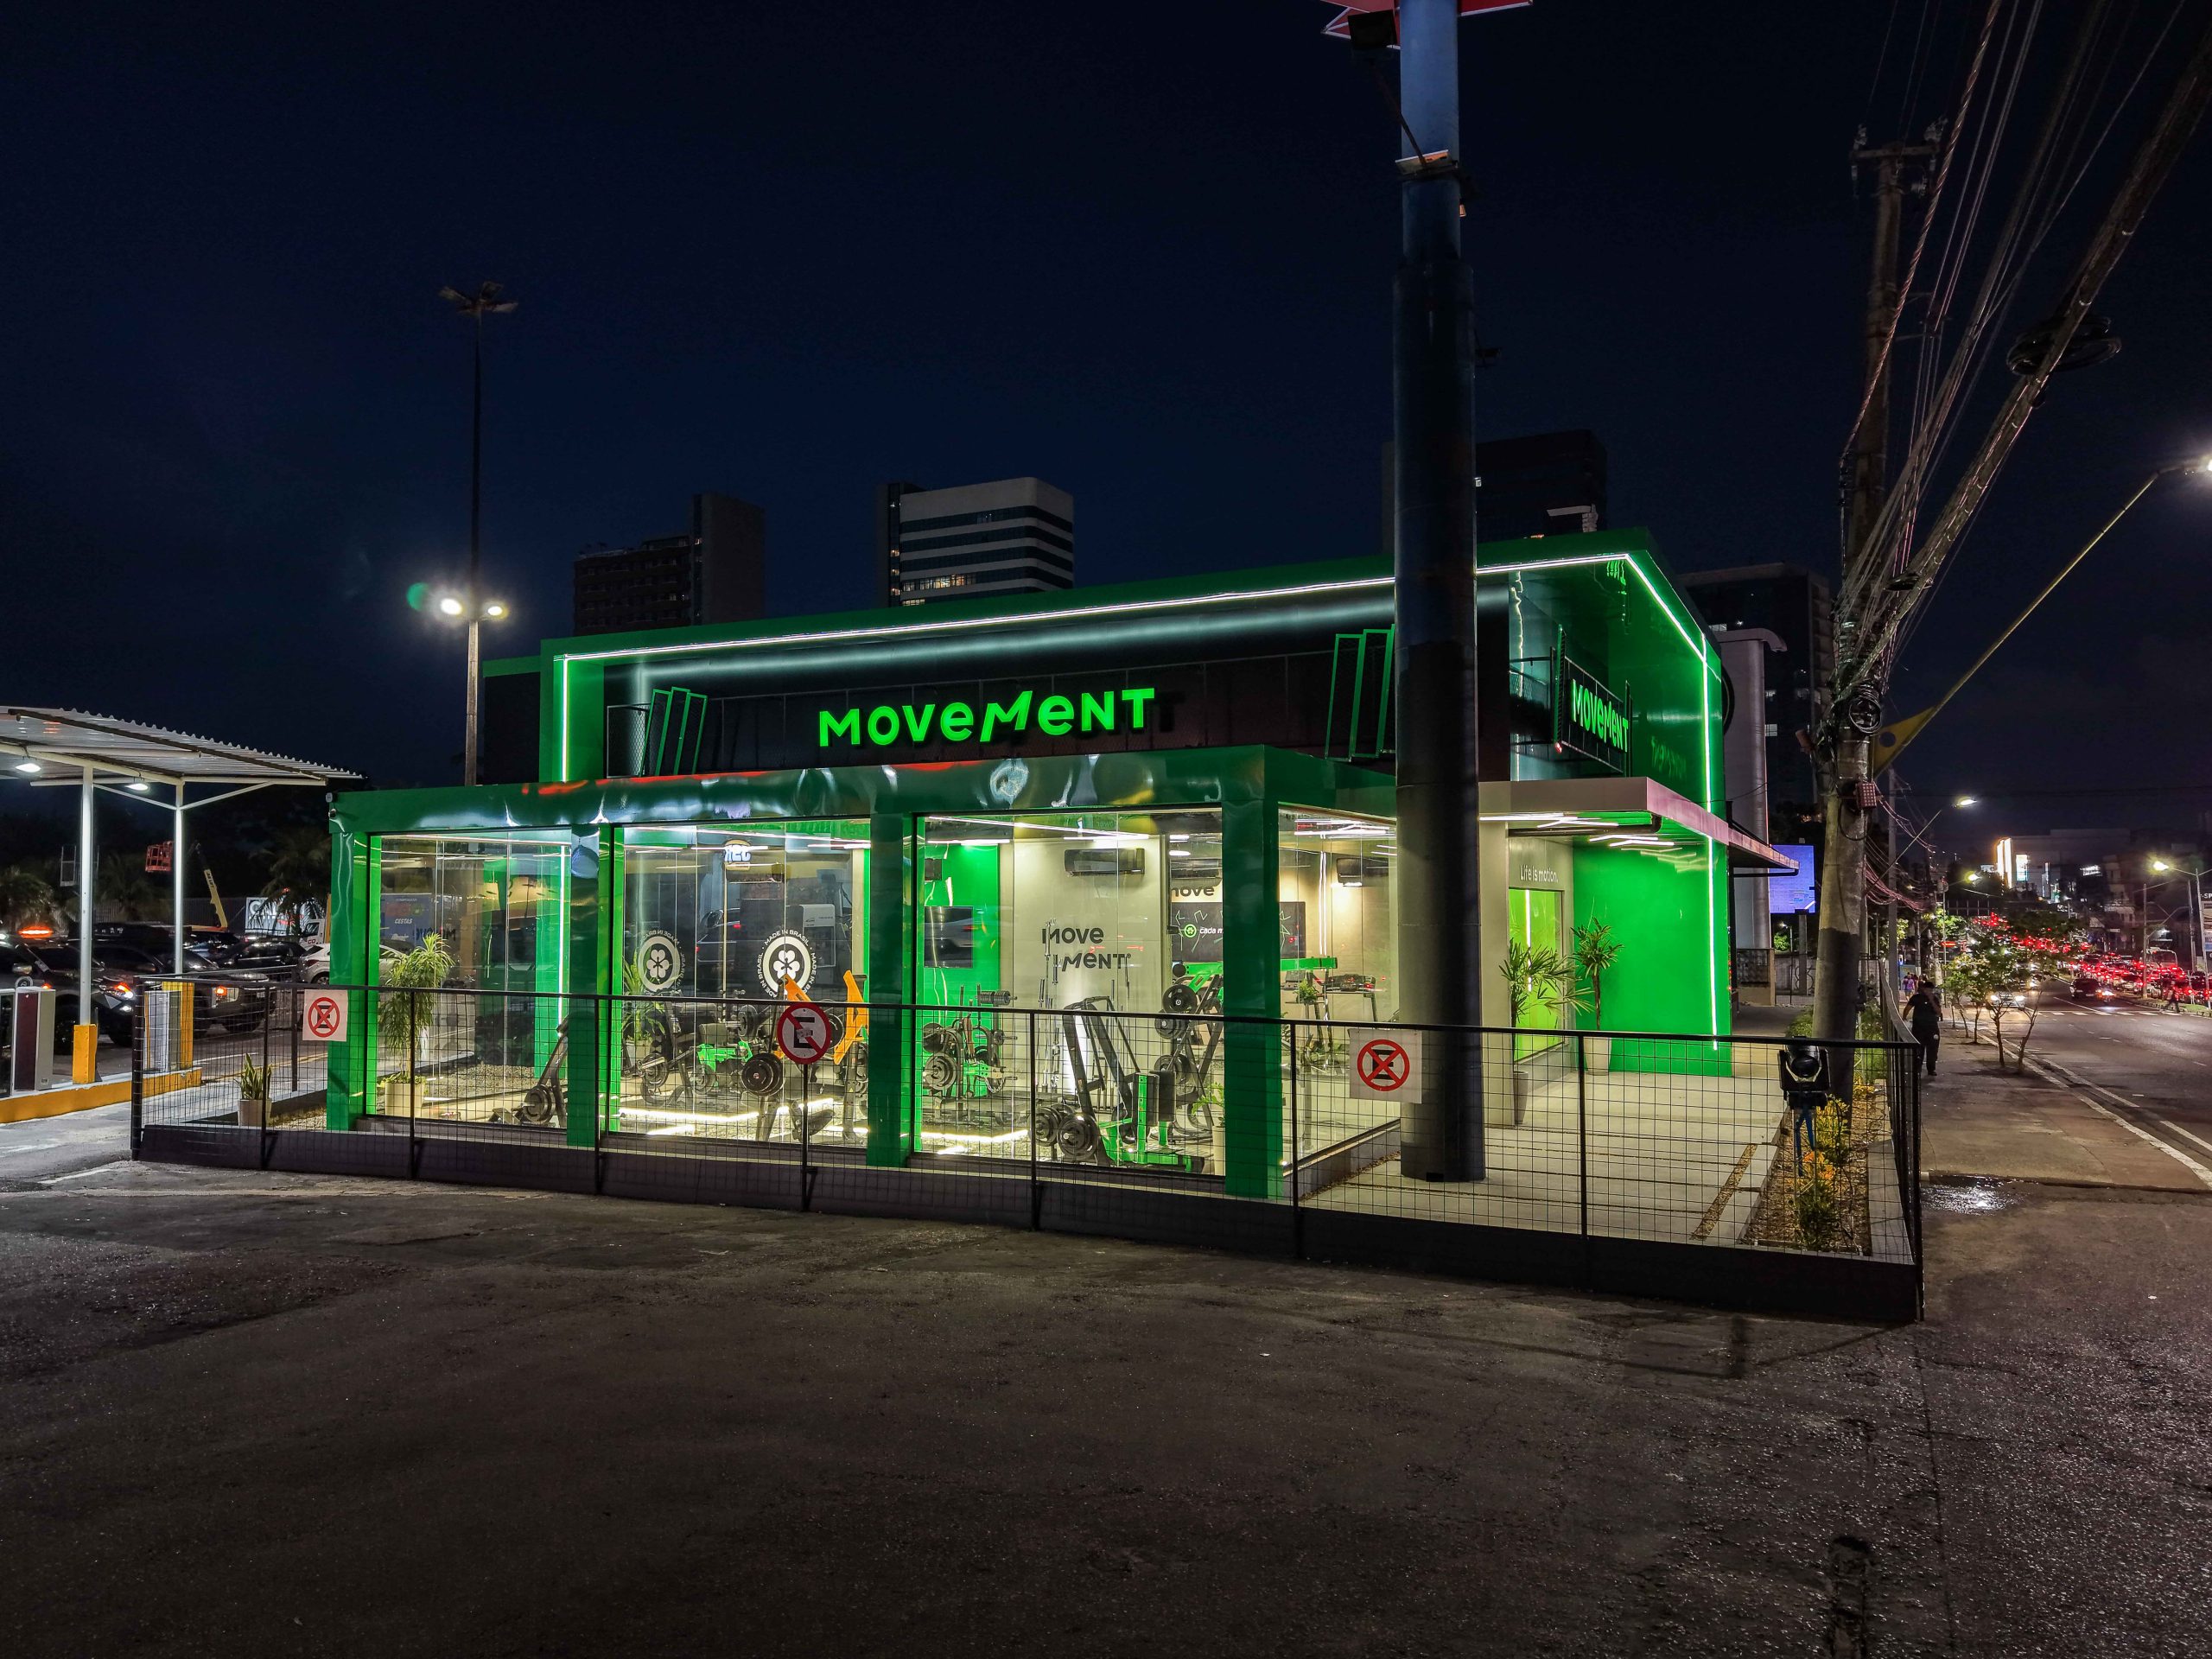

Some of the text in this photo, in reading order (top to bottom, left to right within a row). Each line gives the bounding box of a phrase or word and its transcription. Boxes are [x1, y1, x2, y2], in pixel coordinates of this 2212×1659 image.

[1520, 864, 1532, 880] Life
[764, 930, 781, 946] MADE
[789, 929, 810, 946] BRASIL
